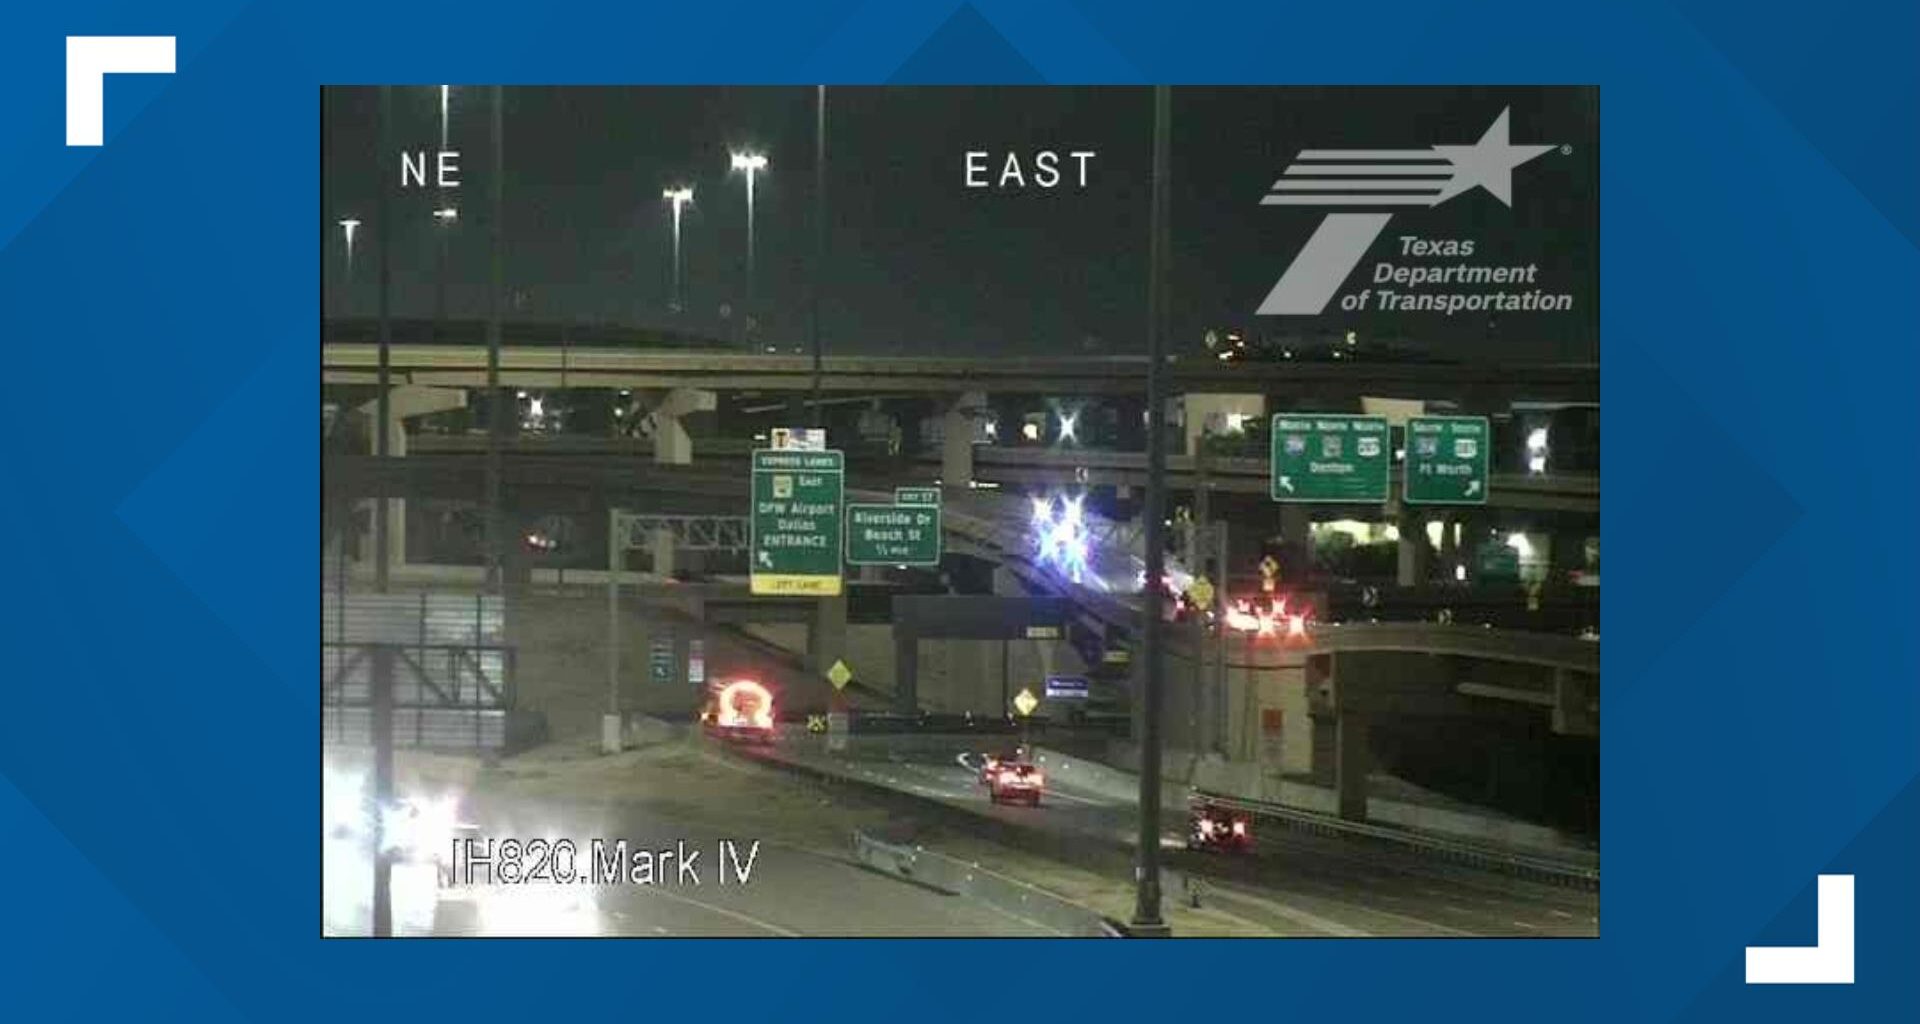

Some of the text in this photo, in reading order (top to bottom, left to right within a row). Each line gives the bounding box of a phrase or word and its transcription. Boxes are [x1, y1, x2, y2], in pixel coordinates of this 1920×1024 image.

[791, 502, 834, 515] Airport
[854, 512, 931, 525] Riverside Dr
[777, 519, 816, 531] Dallas
[763, 535, 826, 547] ENTRANCE
[864, 529, 921, 541] Beach St
